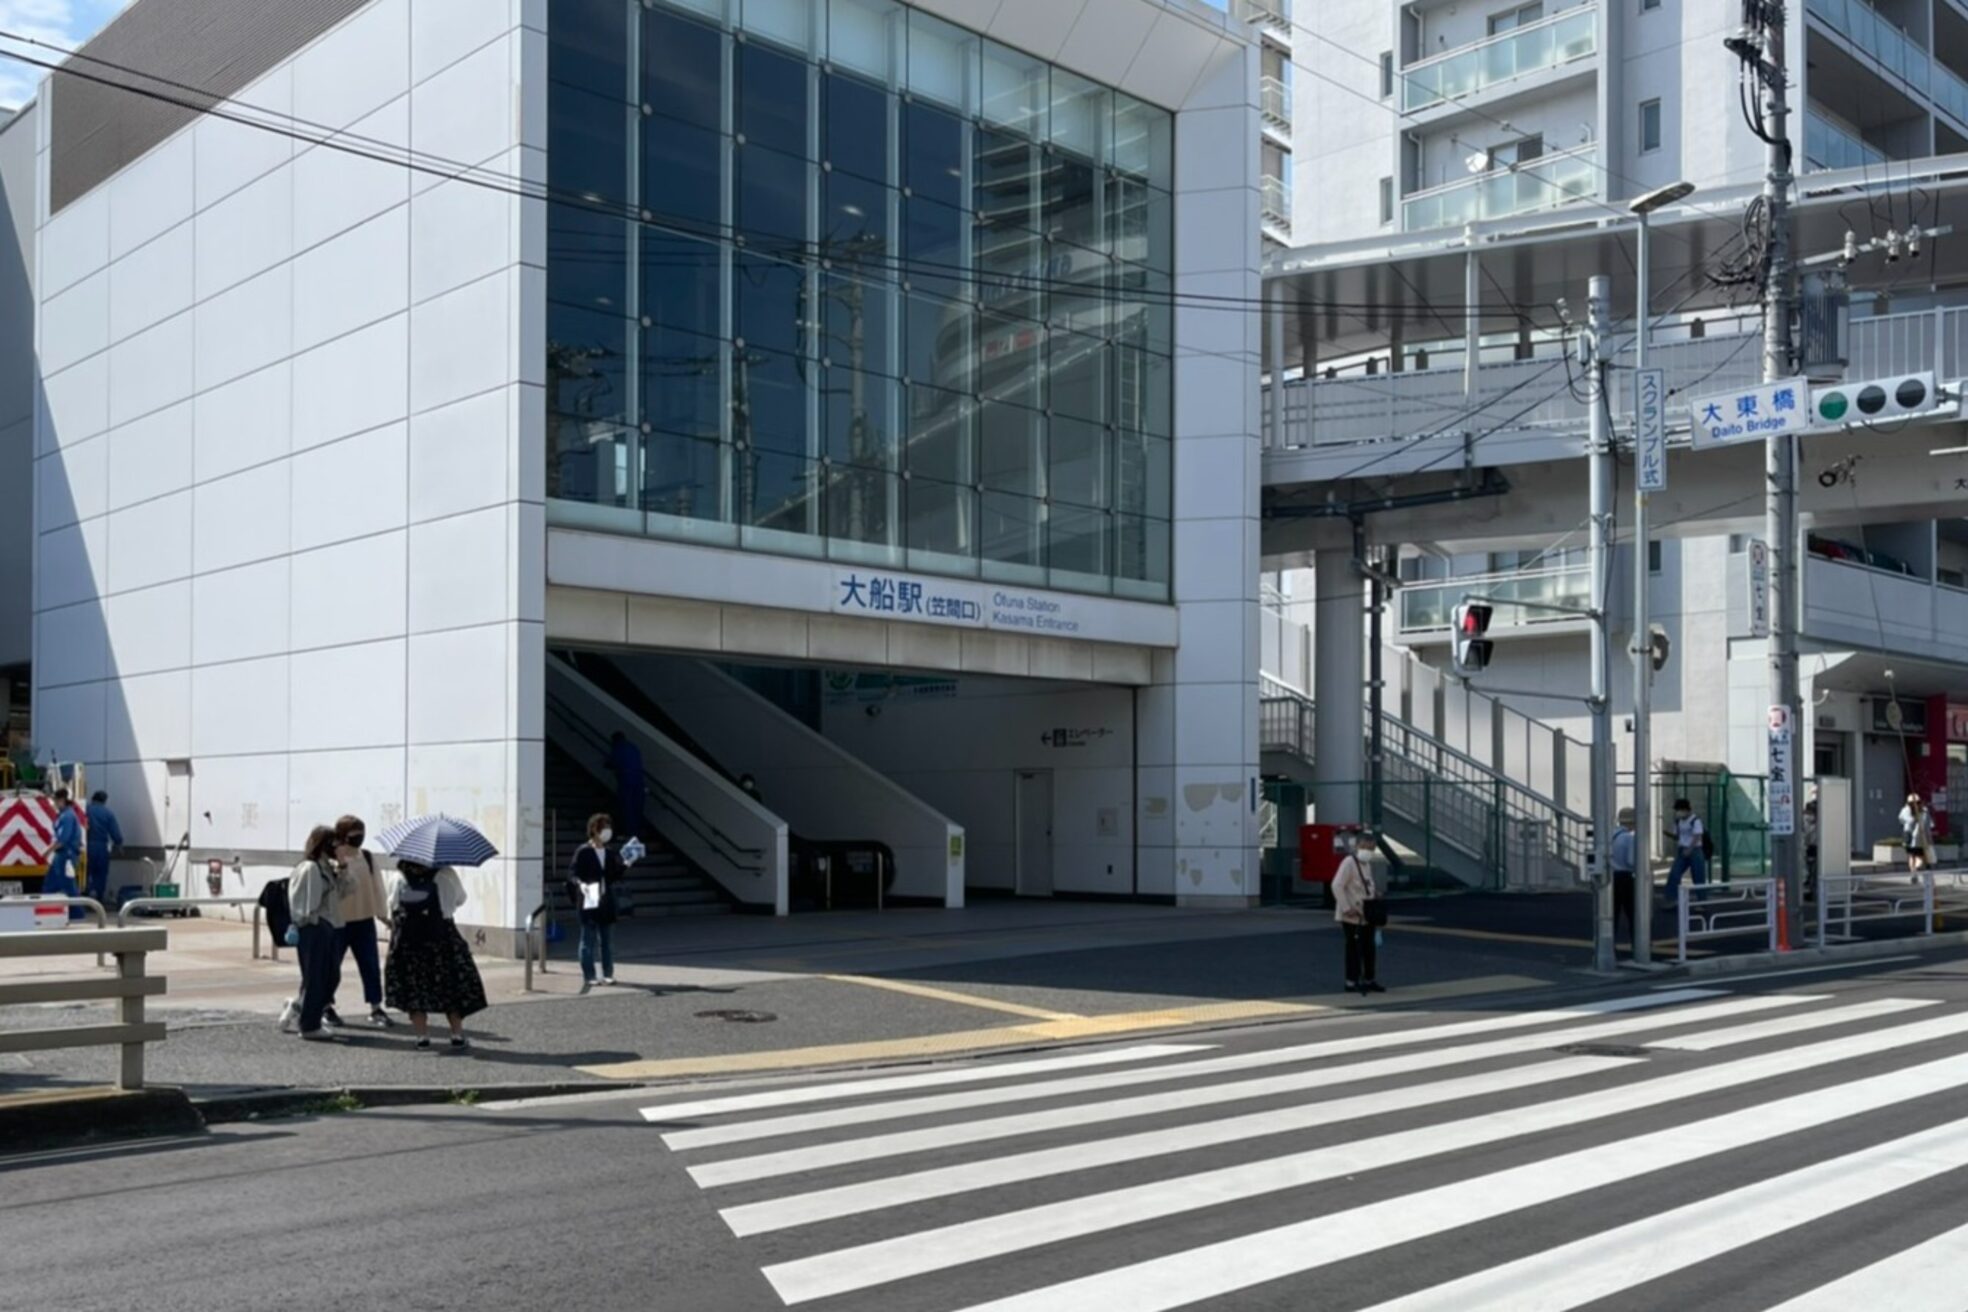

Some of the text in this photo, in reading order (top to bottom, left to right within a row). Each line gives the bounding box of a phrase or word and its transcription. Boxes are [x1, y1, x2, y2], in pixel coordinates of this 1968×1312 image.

[1702, 387, 1795, 425] 大東橋
[1641, 374, 1660, 485] スクランブル式
[1711, 416, 1786, 438] Daito Bridge
[1026, 596, 1061, 612] Station
[993, 611, 1079, 632] Kasama Entrance
